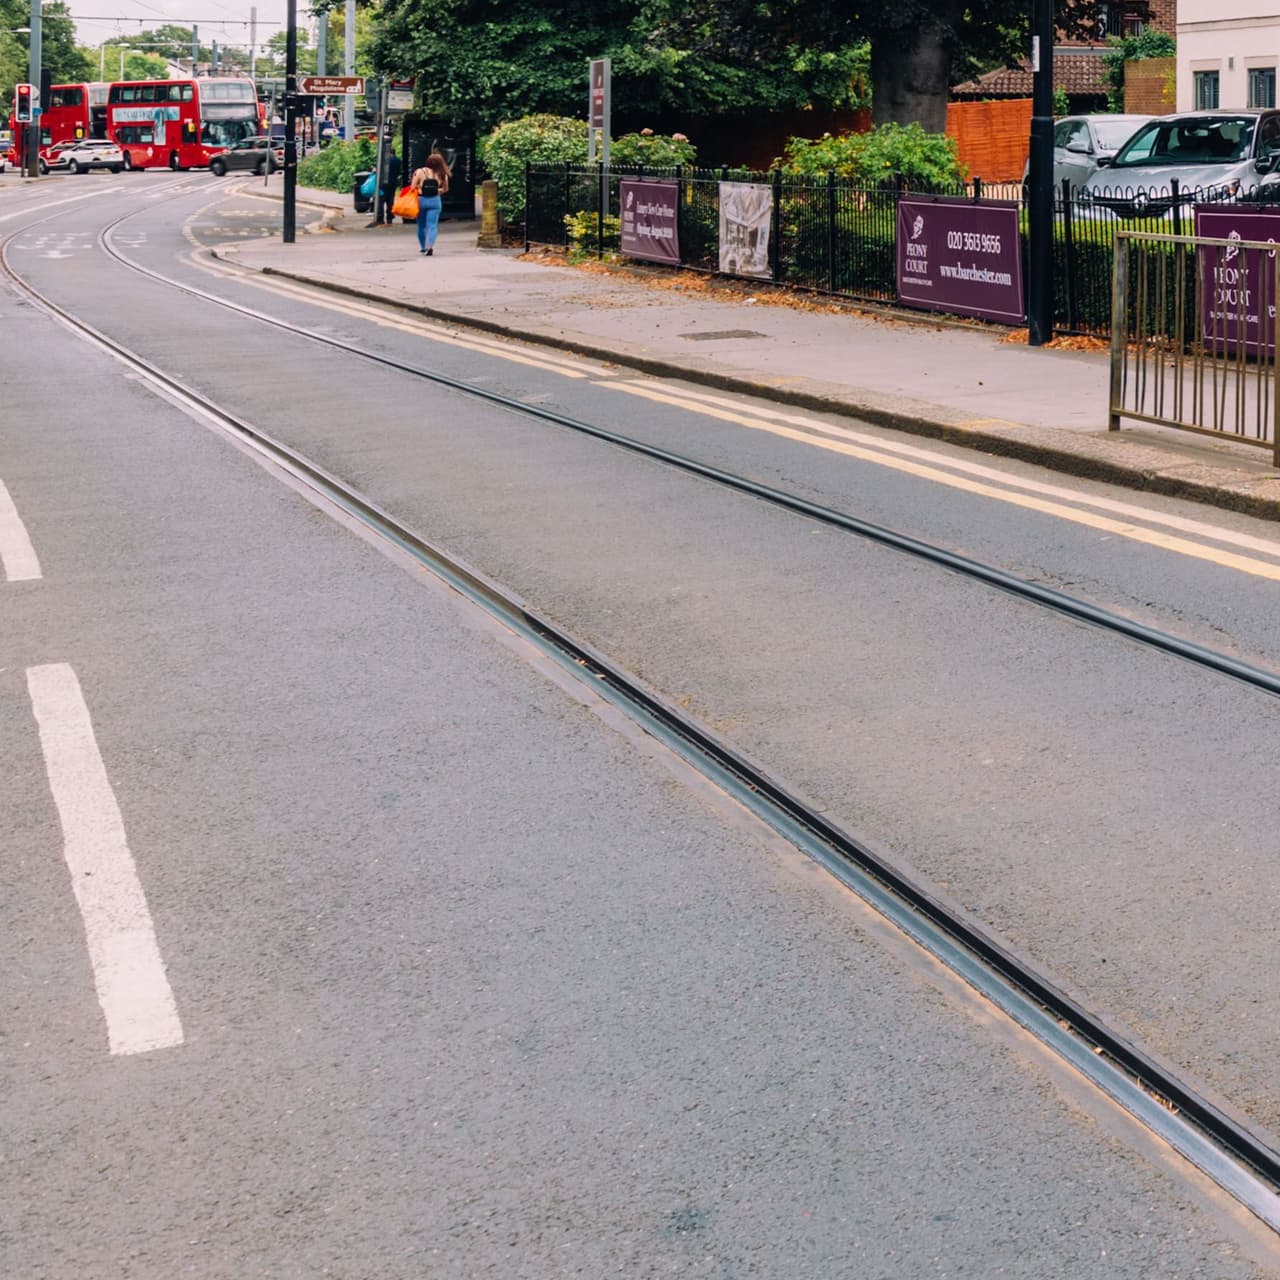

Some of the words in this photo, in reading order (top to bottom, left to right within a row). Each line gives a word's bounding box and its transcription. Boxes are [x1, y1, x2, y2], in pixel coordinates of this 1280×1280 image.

[906, 242, 928, 258] PEONY
[947, 231, 962, 250] 020
[963, 233, 981, 252] 3613
[981, 234, 1001, 255] 9656
[905, 258, 928, 274] COURT
[940, 261, 1012, 286] www.barchester.com
[1214, 266, 1249, 285] EON
